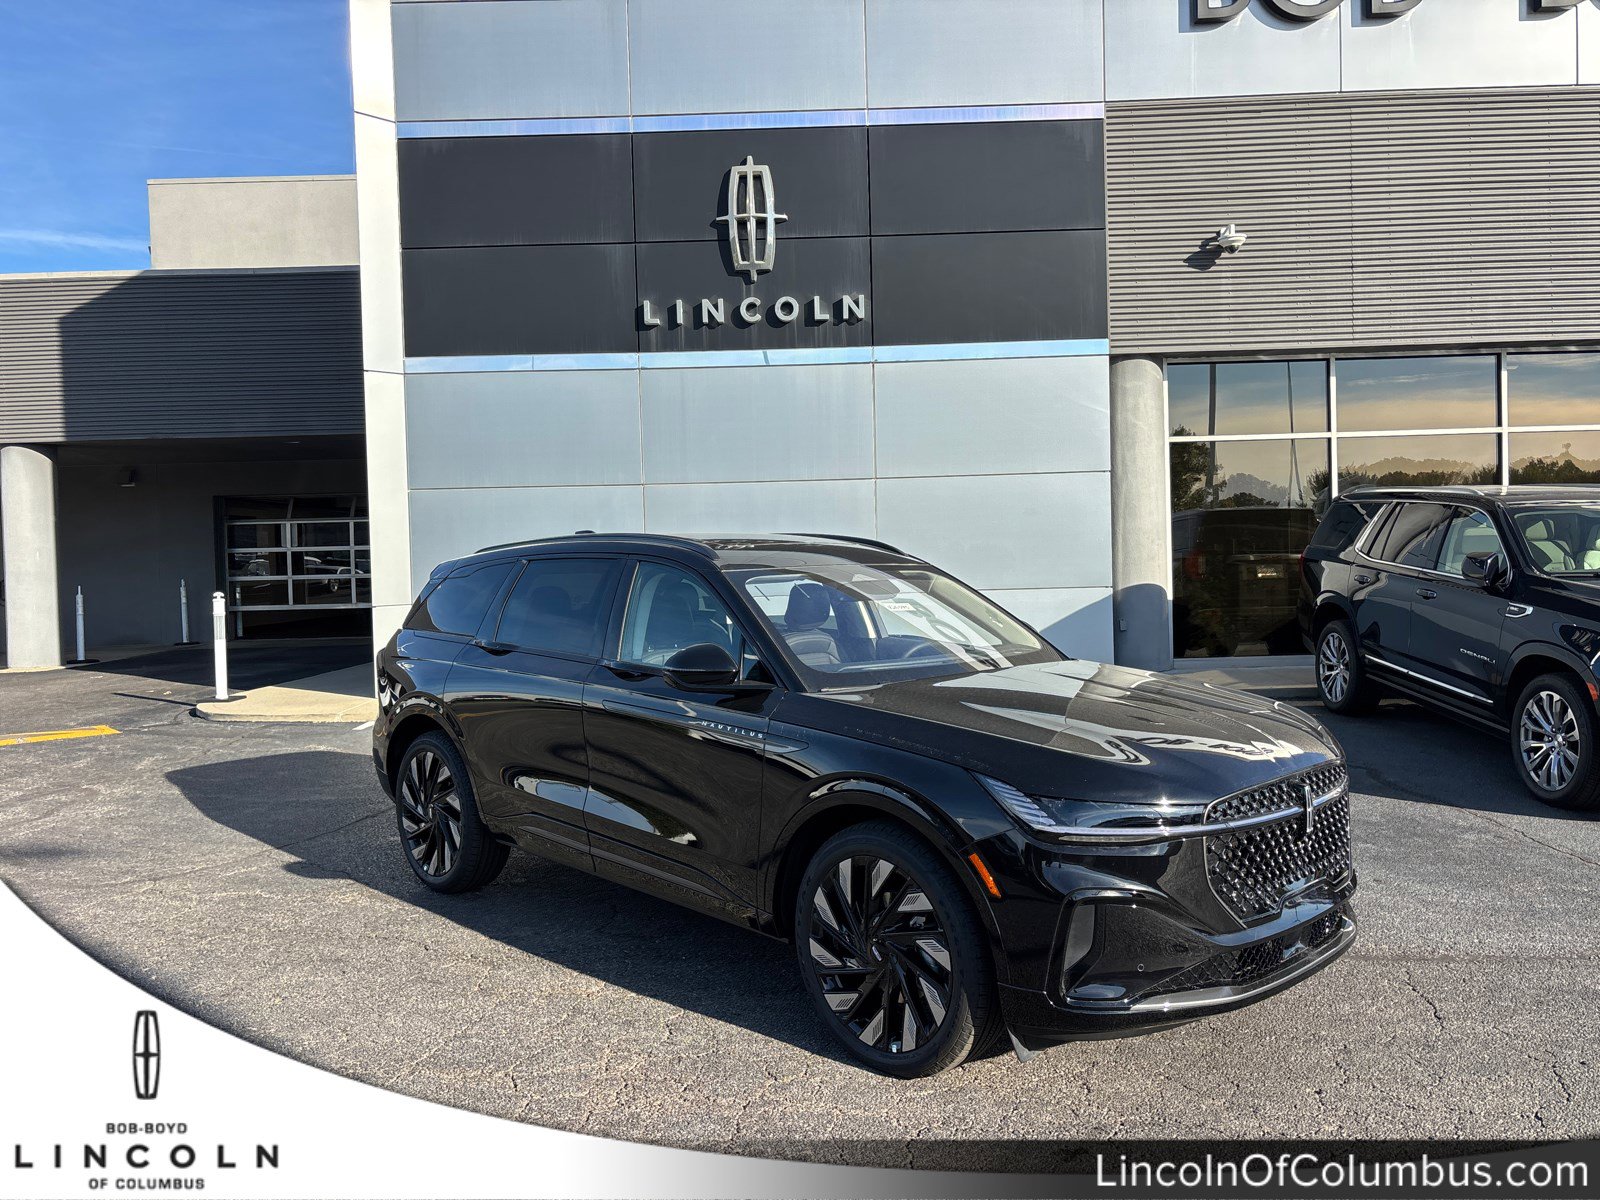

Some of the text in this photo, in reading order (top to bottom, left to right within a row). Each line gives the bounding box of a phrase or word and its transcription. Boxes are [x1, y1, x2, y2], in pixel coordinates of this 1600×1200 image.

[643, 294, 865, 326] LINCOLN
[1460, 648, 1496, 664] DENALI
[701, 720, 763, 739] NAUTILUS
